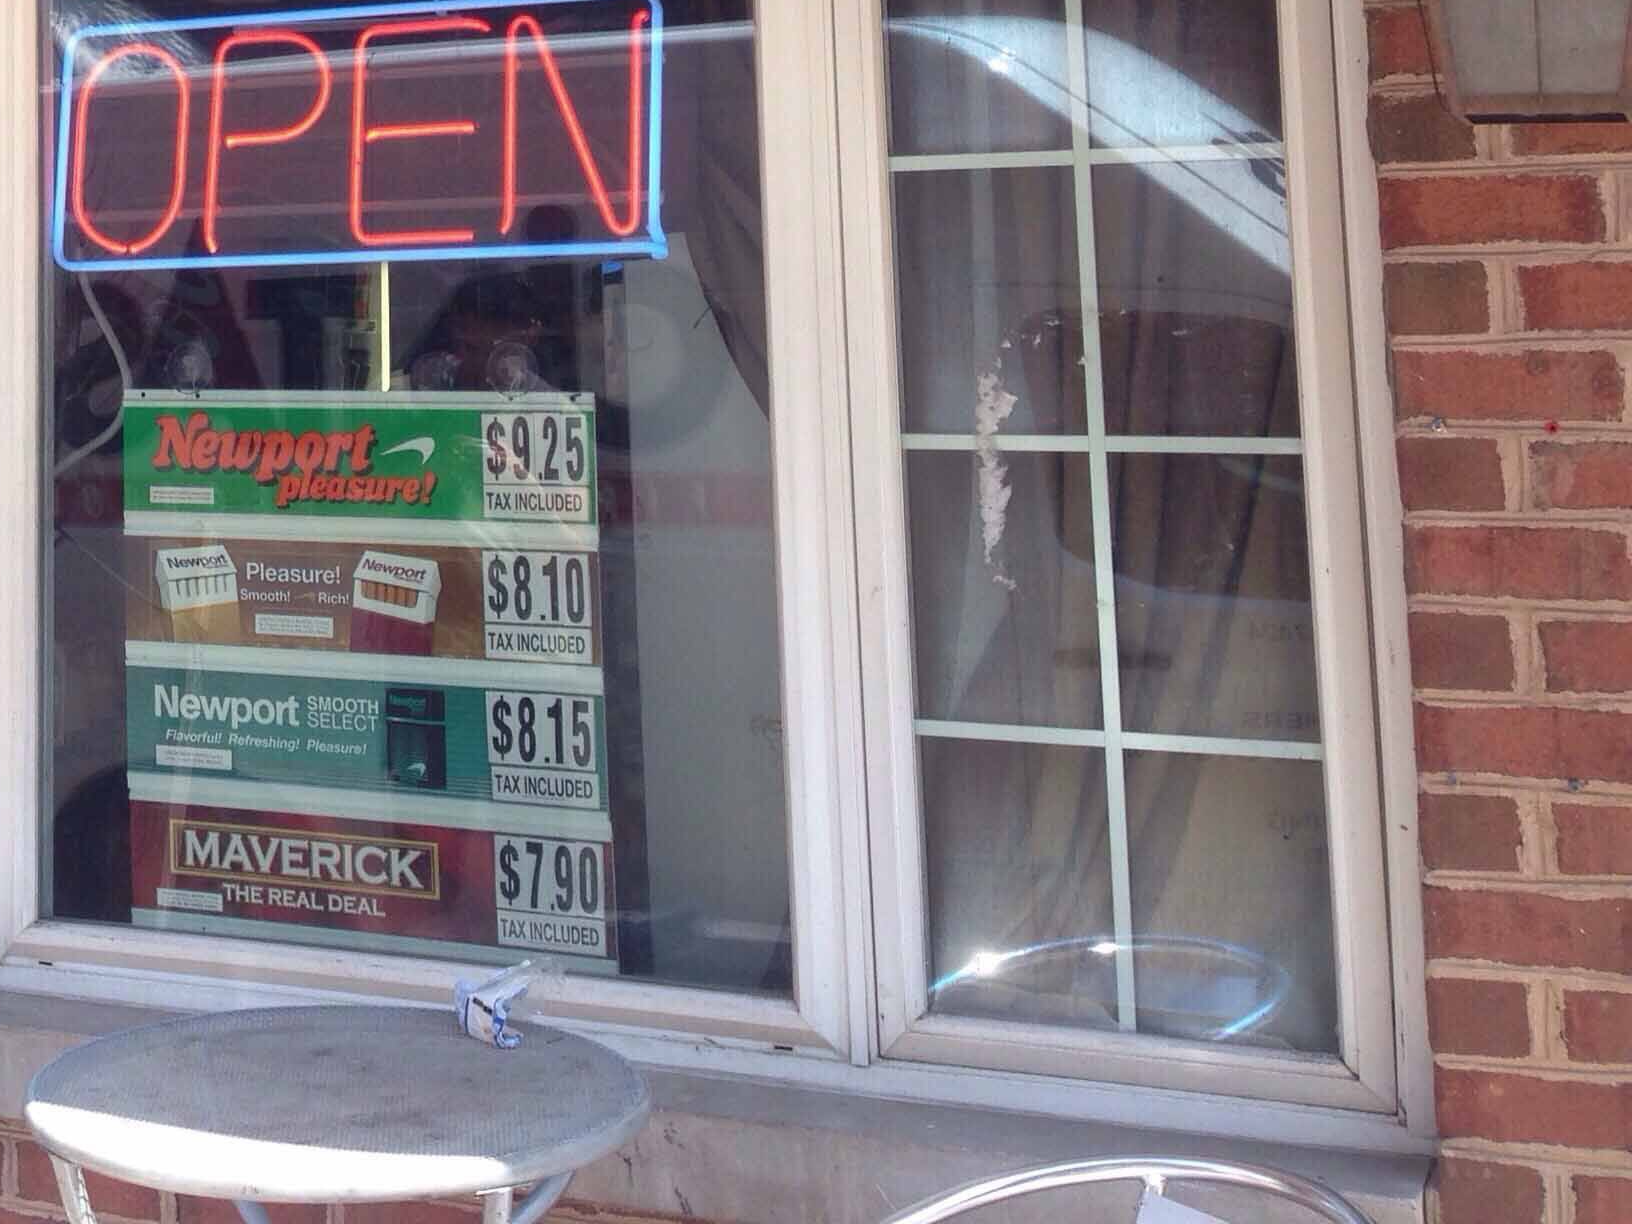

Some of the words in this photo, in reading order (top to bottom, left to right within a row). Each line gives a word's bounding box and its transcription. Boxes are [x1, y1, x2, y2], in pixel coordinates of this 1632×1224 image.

[72, 9, 651, 255] OPEN
[152, 409, 377, 485] Newport
[486, 416, 585, 482] $9.25
[275, 466, 437, 509] pleasure!
[486, 491, 512, 511] TAX
[515, 493, 583, 513] INCLUDED
[167, 553, 228, 569] Newport
[246, 561, 341, 585] Pleasure!
[361, 558, 428, 580] Newport
[240, 587, 291, 603] Smooth!
[318, 591, 350, 606] Rich!
[488, 554, 585, 625] $8.10
[488, 632, 514, 652] TAX
[517, 632, 585, 655] INCLUDED
[154, 683, 300, 729] Newport
[307, 694, 380, 715] SMOOTH
[307, 712, 380, 733] SELECT
[492, 695, 592, 768] $8.15
[165, 728, 222, 744] Flavorful!
[228, 732, 301, 752] Refreshing!
[306, 738, 367, 756] Pleasure!
[495, 774, 520, 794] TAX
[524, 775, 593, 799] INCLUDED
[183, 829, 425, 889] MAVERICK
[499, 840, 598, 915] $7.90
[222, 881, 264, 905] THE
[268, 888, 325, 912] REAL
[328, 895, 387, 917] DEAL
[500, 918, 526, 940] TAX
[529, 920, 600, 946] INCLUDED
